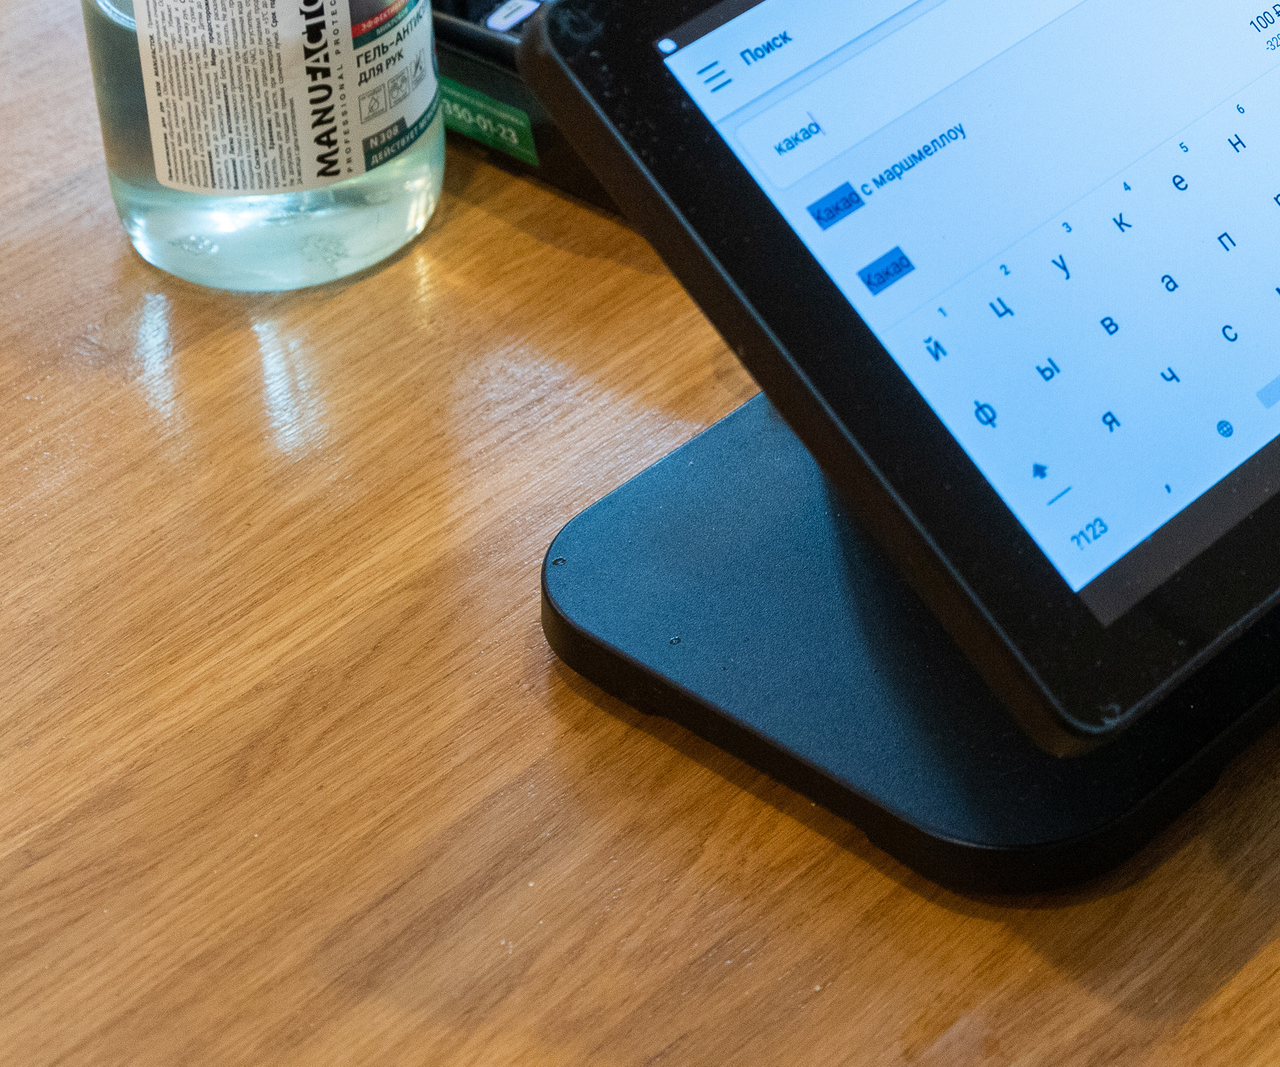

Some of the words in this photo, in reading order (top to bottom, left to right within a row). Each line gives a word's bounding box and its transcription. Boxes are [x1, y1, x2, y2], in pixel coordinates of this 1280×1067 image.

[1249, 11, 1275, 33] 100
[739, 30, 793, 66] Поиск
[357, 62, 384, 87] ДЛЯ
[385, 47, 405, 70] РУК
[336, 64, 355, 174] PROFESSIONAL
[1236, 103, 1246, 115] 6
[773, 120, 821, 156] какао
[1178, 141, 1189, 153] 5
[1227, 133, 1247, 153] н
[812, 190, 860, 224] Какао
[861, 182, 873, 196] с
[871, 122, 967, 189] маршмеллоу
[1171, 174, 1189, 192] е
[1123, 181, 1132, 191] 4
[1061, 221, 1073, 234] 3
[1112, 212, 1133, 233] к
[1216, 231, 1237, 252] п
[864, 254, 911, 290] Какао
[999, 263, 1011, 276] 2
[1051, 254, 1071, 281] у
[1160, 274, 1179, 293] а
[936, 307, 948, 319] 1
[988, 295, 1016, 321] ц
[1099, 316, 1120, 336] в
[1221, 324, 1239, 343] с
[923, 336, 947, 362] й
[1035, 357, 1061, 382] ы
[1160, 366, 1181, 383] ч
[973, 400, 997, 429] ф
[1101, 410, 1121, 433] я
[1070, 517, 1109, 551] ?123
